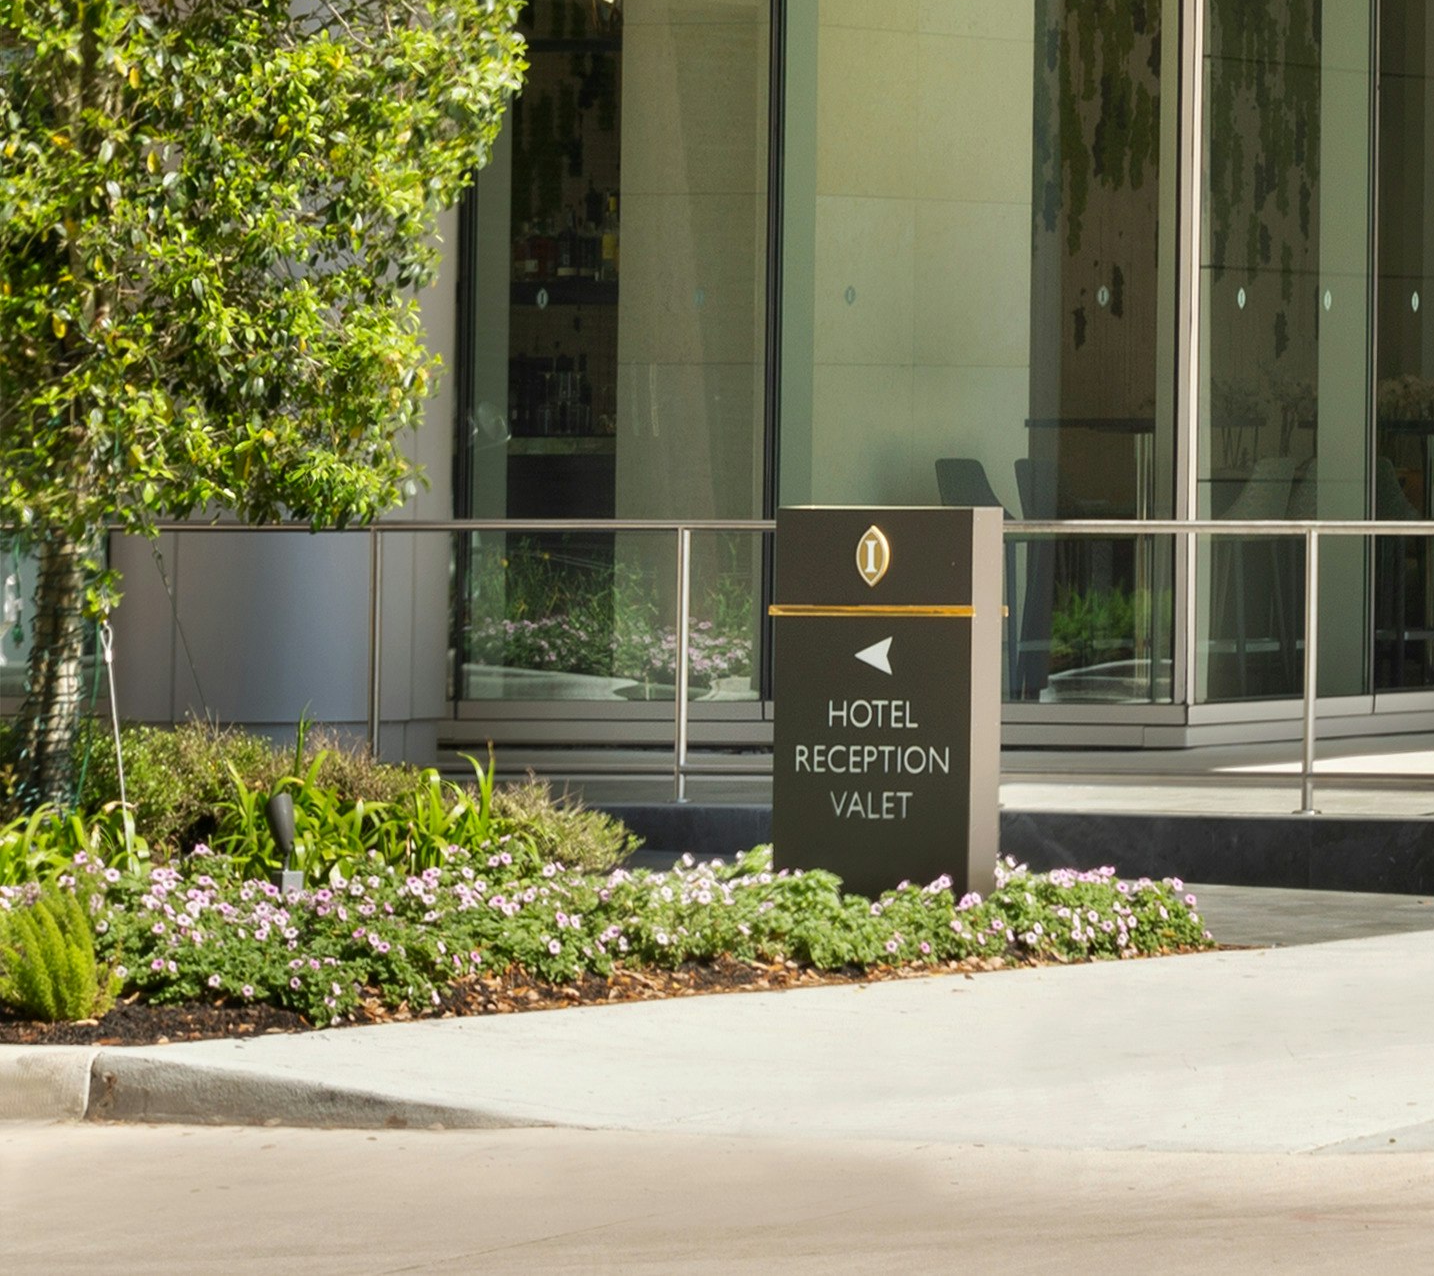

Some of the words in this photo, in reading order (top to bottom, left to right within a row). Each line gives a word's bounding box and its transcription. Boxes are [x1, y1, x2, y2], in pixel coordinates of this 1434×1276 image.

[828, 699, 919, 729] HOTEL
[794, 744, 950, 775] RECEPTION
[829, 790, 914, 820] VALET
